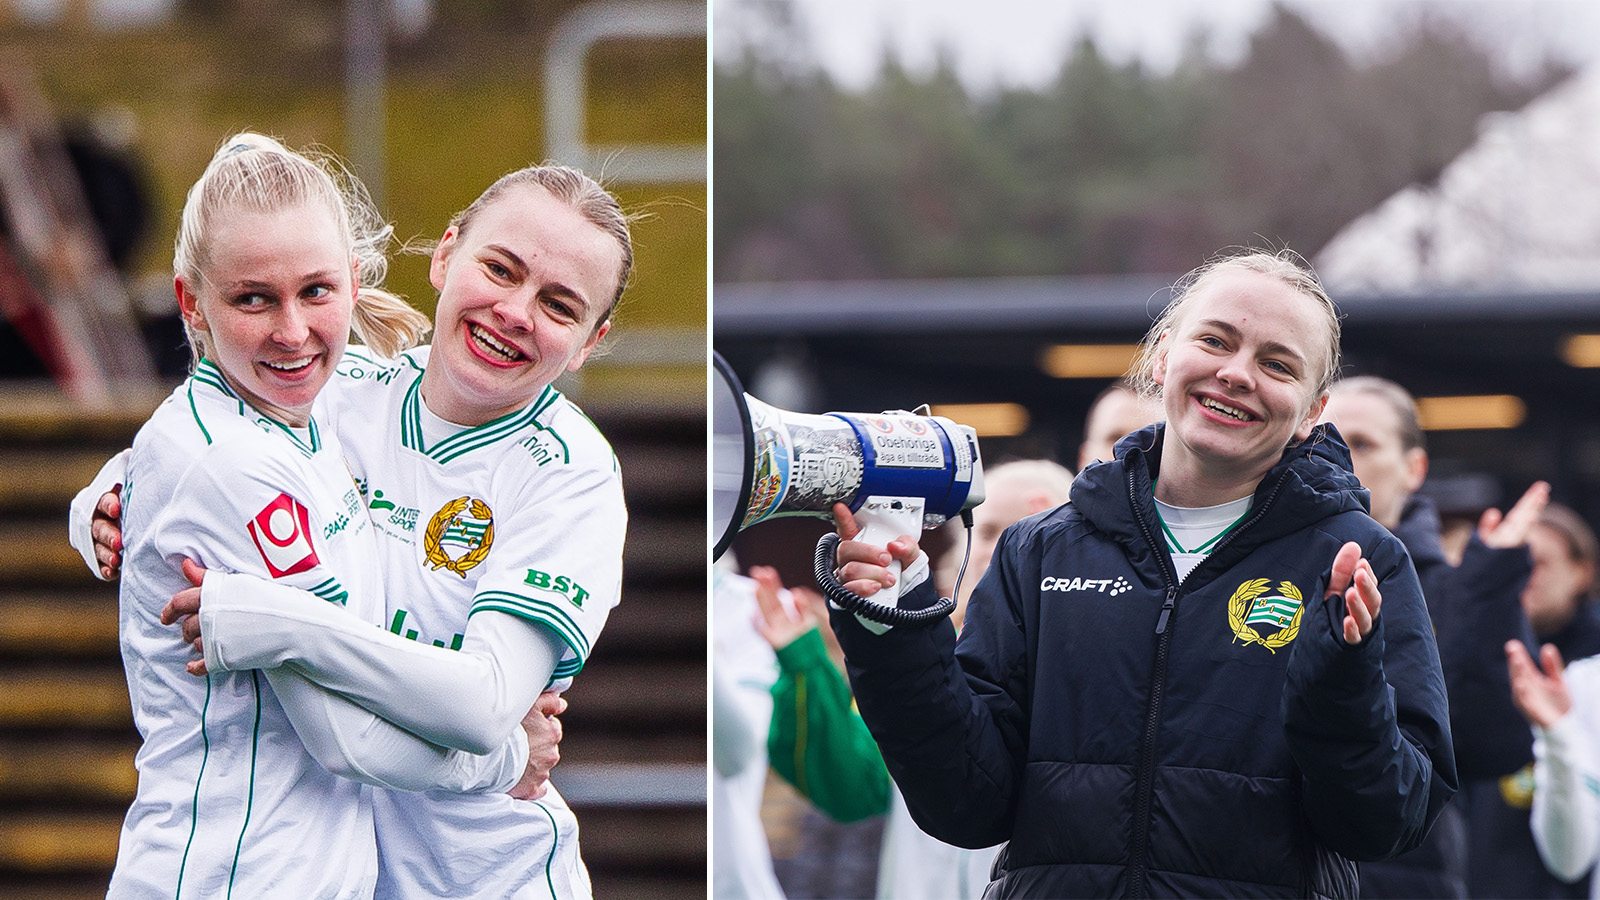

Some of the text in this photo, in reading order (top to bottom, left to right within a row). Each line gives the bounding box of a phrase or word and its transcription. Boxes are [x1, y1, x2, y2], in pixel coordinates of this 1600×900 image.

[877, 435, 937, 452] Obehöriga
[897, 452, 906, 464] ej
[523, 568, 591, 608] BST
[1040, 576, 1114, 593] CRAFT
[1258, 599, 1287, 626] HIF
